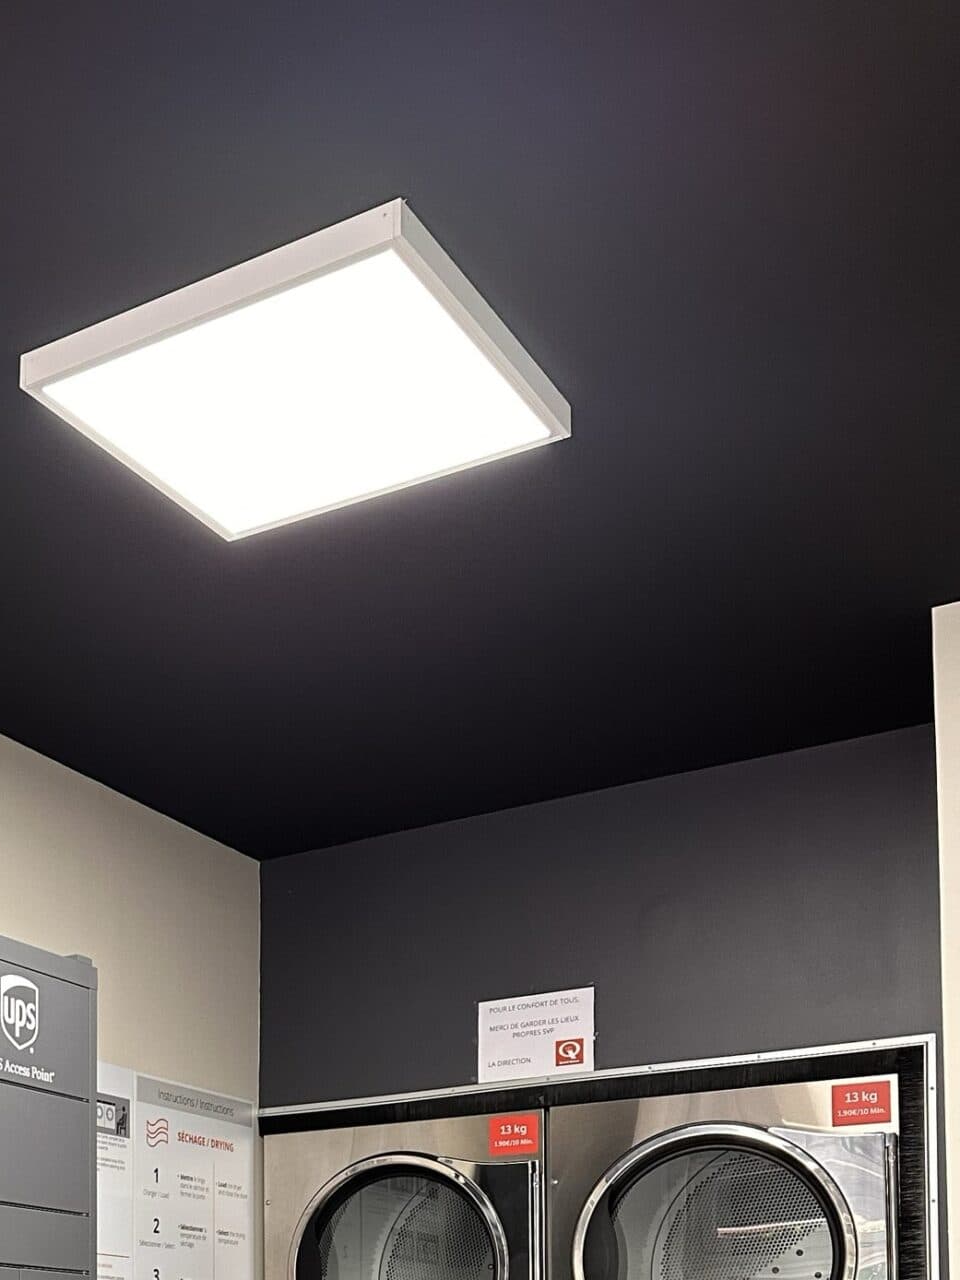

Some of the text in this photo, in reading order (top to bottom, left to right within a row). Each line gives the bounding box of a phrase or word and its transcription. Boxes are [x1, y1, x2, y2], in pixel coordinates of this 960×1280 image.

[489, 1005, 507, 1014] POUR
[508, 1004, 516, 1012] LE
[517, 1000, 548, 1011] CONFORT
[549, 998, 559, 1006] DE
[3, 995, 36, 1037] ups
[489, 1023, 509, 1032] MERCI
[520, 1018, 547, 1028] GARDER
[548, 1017, 559, 1025] LES
[560, 1015, 579, 1023] LIEUX
[512, 1029, 541, 1038] PROPRES
[4, 1059, 31, 1077] Access
[488, 1057, 531, 1068] LA DIRECTION
[845, 1090, 878, 1104] 13 kg
[500, 1124, 528, 1136] 13 kg
[177, 1130, 206, 1147] SÉCHAGE
[211, 1138, 235, 1152] DRYING
[153, 1168, 159, 1183] 1
[153, 1218, 161, 1234] 2
